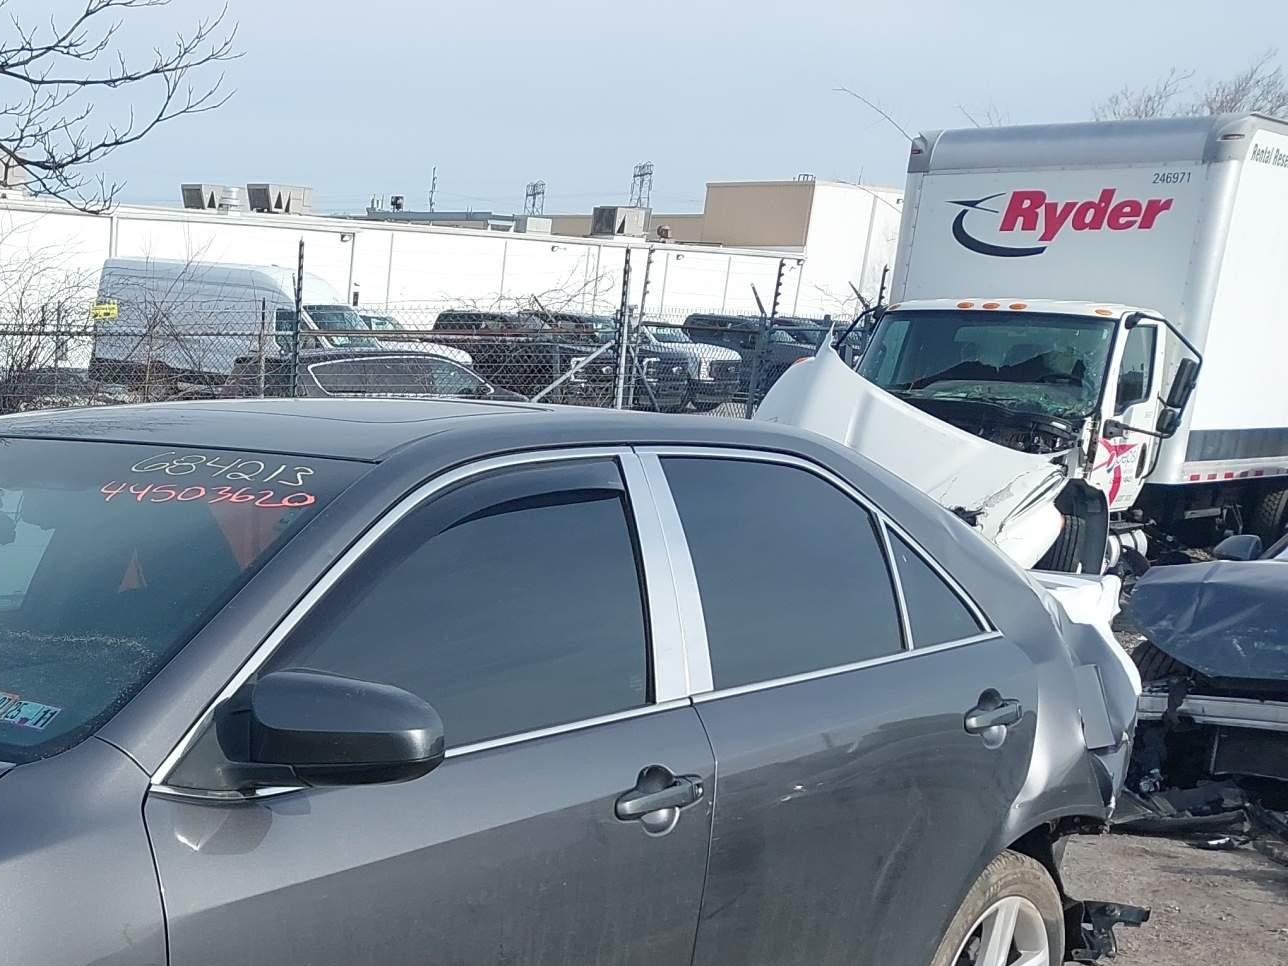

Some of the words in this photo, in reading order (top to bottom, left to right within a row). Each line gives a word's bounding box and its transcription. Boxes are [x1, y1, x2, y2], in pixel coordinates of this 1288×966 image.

[1250, 143, 1274, 165] Rental
[1152, 172, 1192, 184] 246971
[999, 188, 1174, 242] Ryder
[131, 451, 314, 486] 684213
[100, 480, 316, 508] 44503620
[32, 709, 58, 728] 11
